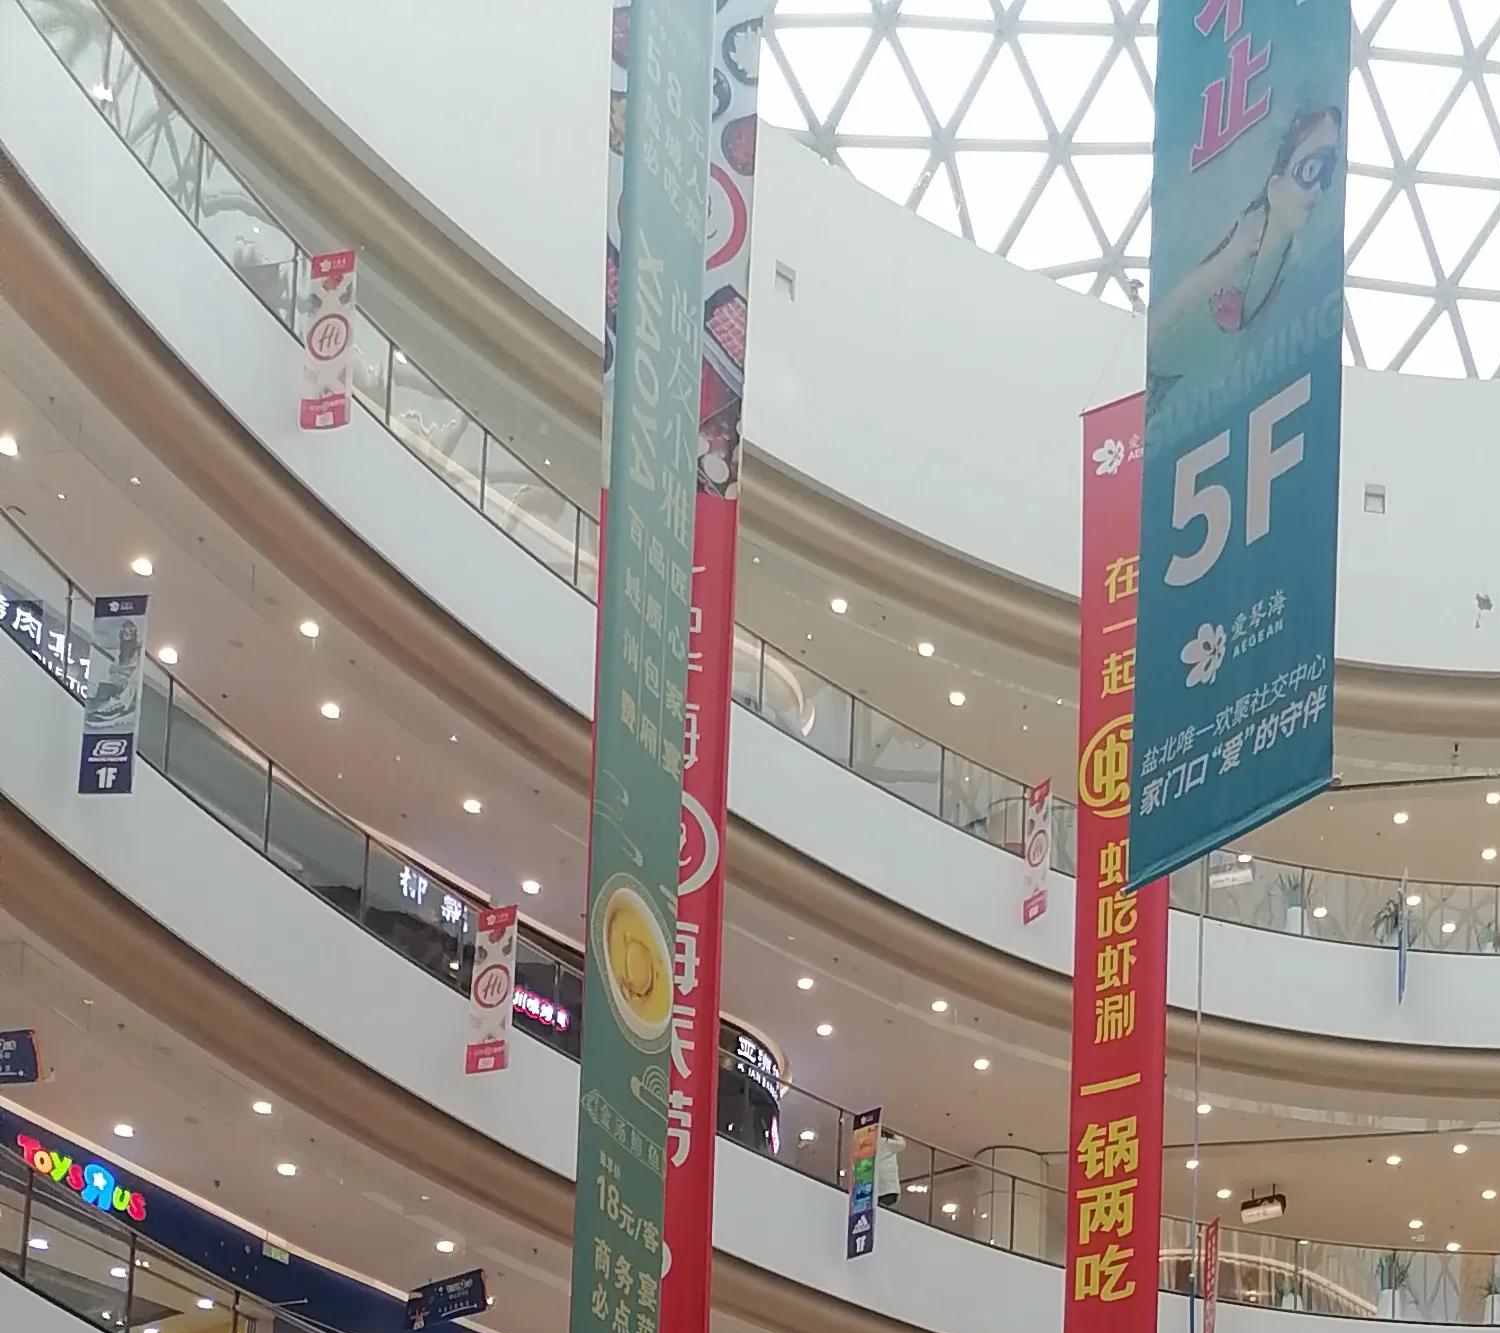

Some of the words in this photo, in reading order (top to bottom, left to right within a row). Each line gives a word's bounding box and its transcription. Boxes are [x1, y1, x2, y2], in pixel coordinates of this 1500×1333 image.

[1163, 374, 1311, 588] 5F
[1232, 618, 1284, 659] AEGEAN
[96, 767, 118, 789] 1F
[1073, 1069, 1142, 1303] 一锅两吃
